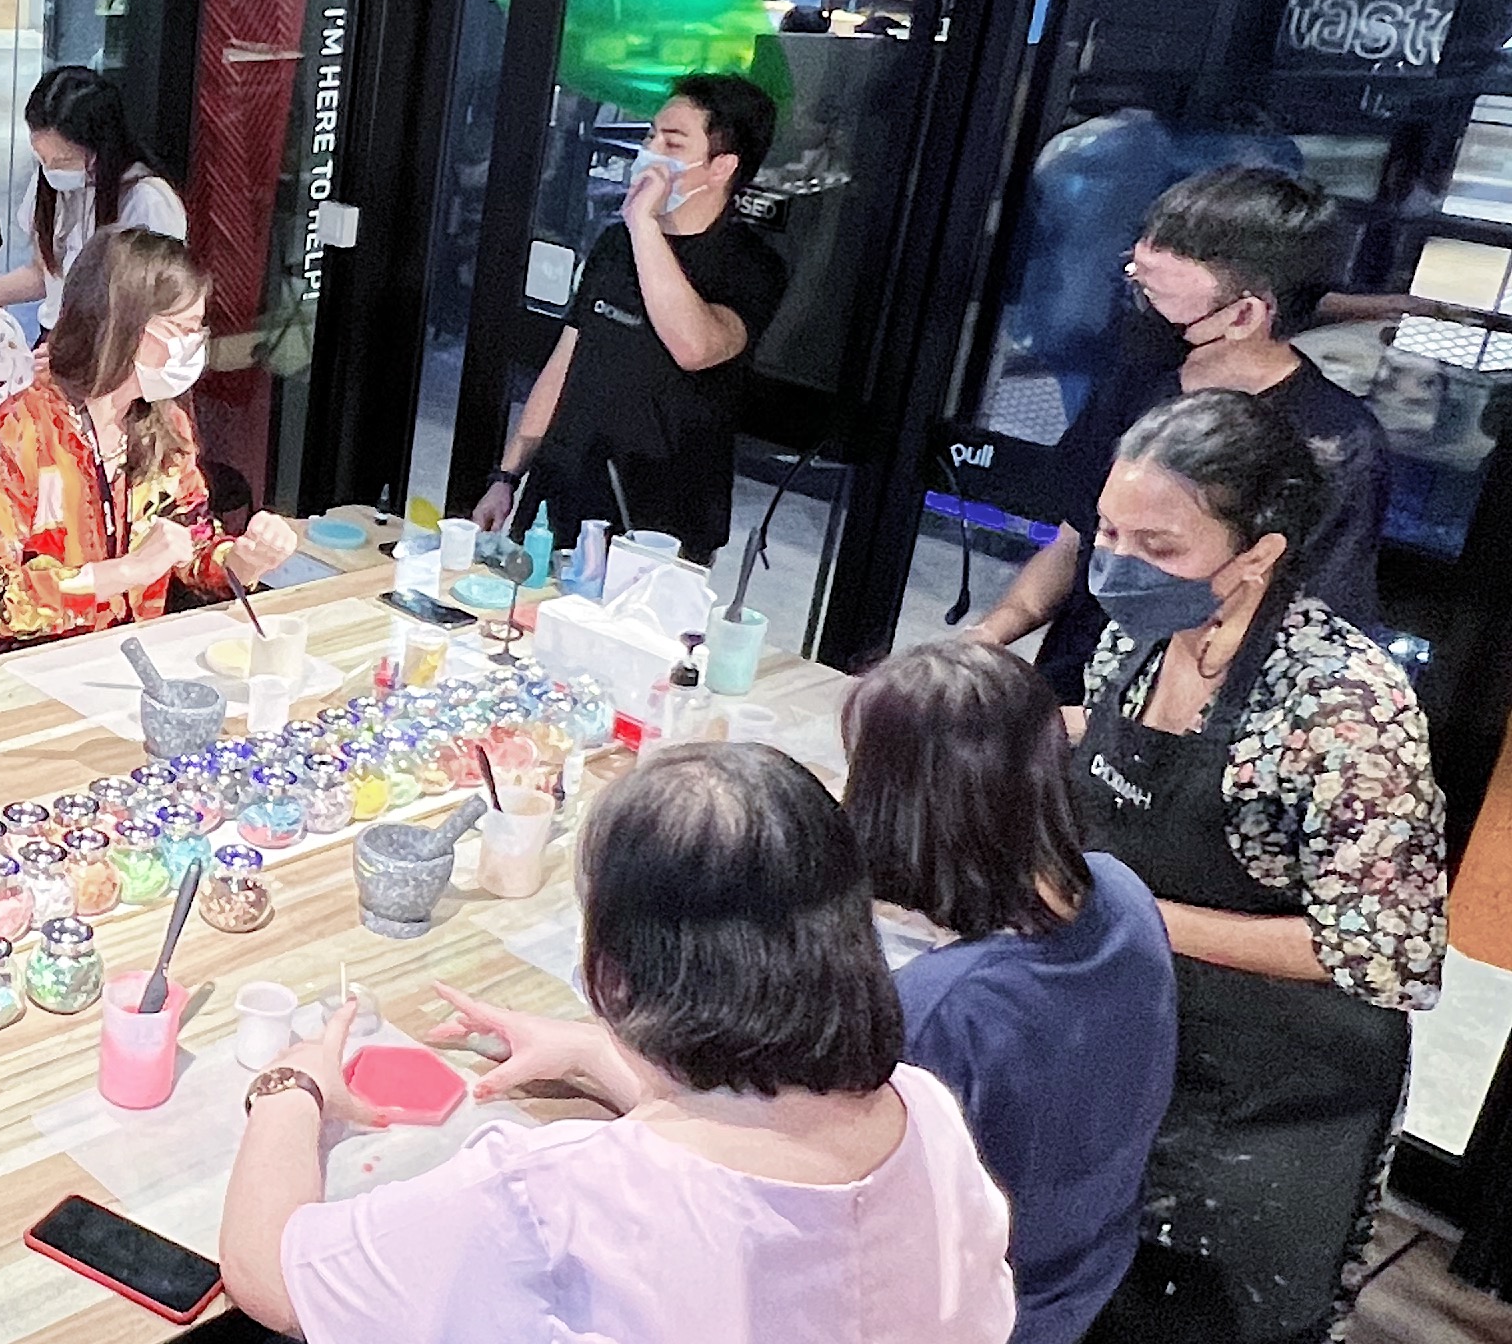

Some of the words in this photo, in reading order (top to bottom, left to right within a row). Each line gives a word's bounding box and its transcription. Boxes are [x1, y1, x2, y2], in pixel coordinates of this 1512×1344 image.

[320, 7, 347, 56] I'M
[312, 65, 342, 154] HERE
[309, 159, 334, 200] TO
